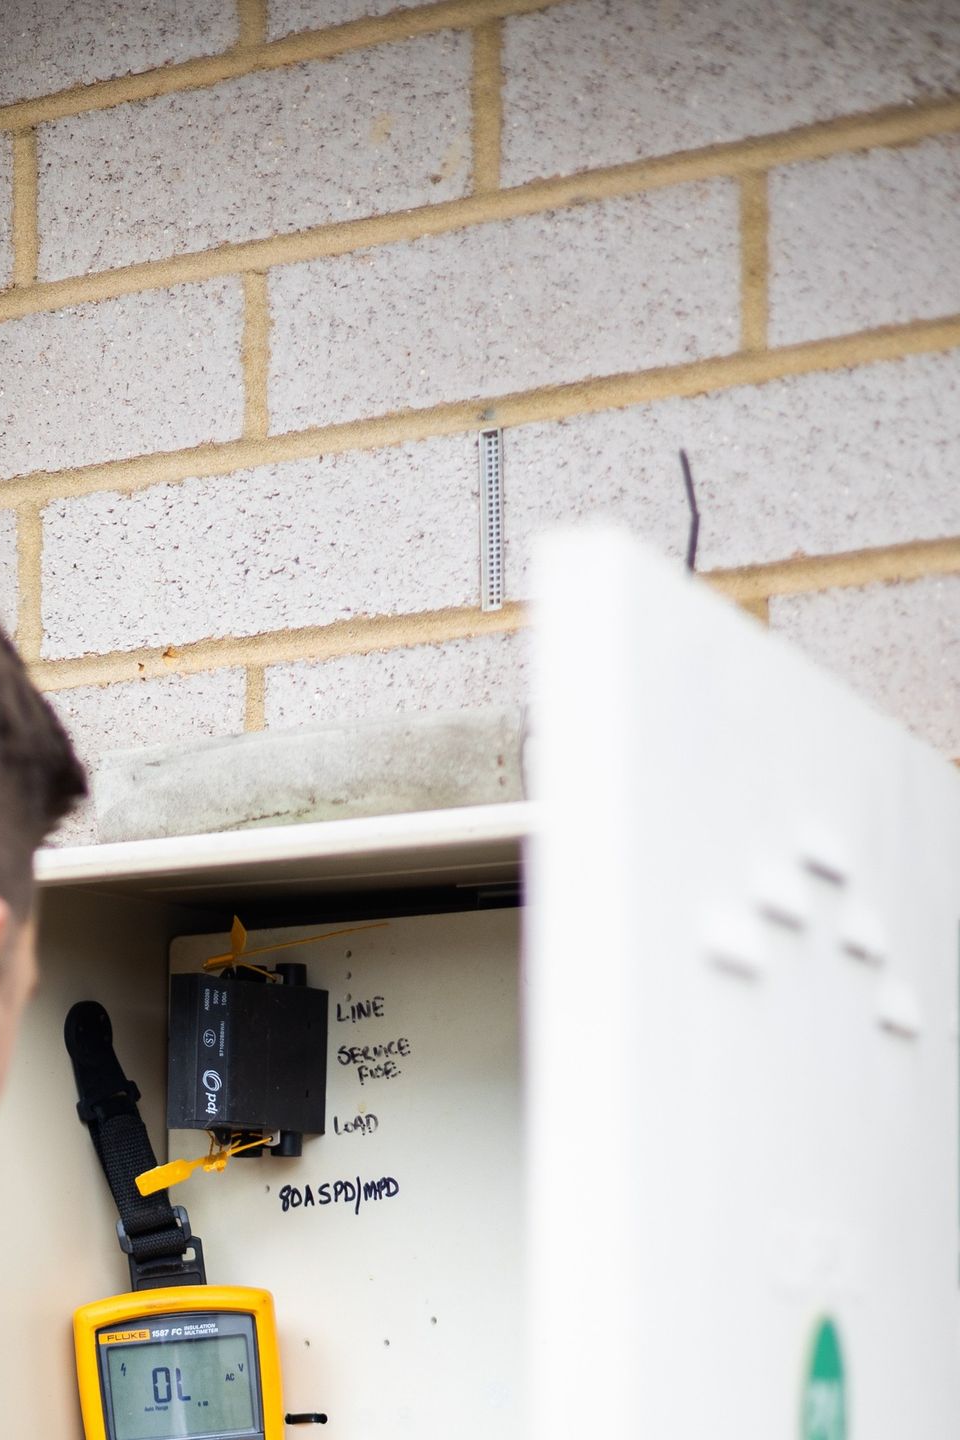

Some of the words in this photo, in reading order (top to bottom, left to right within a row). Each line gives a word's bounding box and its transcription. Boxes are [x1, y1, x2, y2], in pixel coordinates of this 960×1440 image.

[336, 996, 384, 1023] LINE
[337, 1037, 411, 1066] SERVICE
[205, 1092, 218, 1114] ipd
[183, 1322, 216, 1331] INSULATION
[183, 1327, 219, 1336] MULTIMETER
[107, 1332, 147, 1342] FLUKE
[151, 1329, 169, 1338] 1587
[171, 1328, 182, 1336] FC
[238, 1363, 244, 1372] V
[225, 1372, 235, 1382] AC
